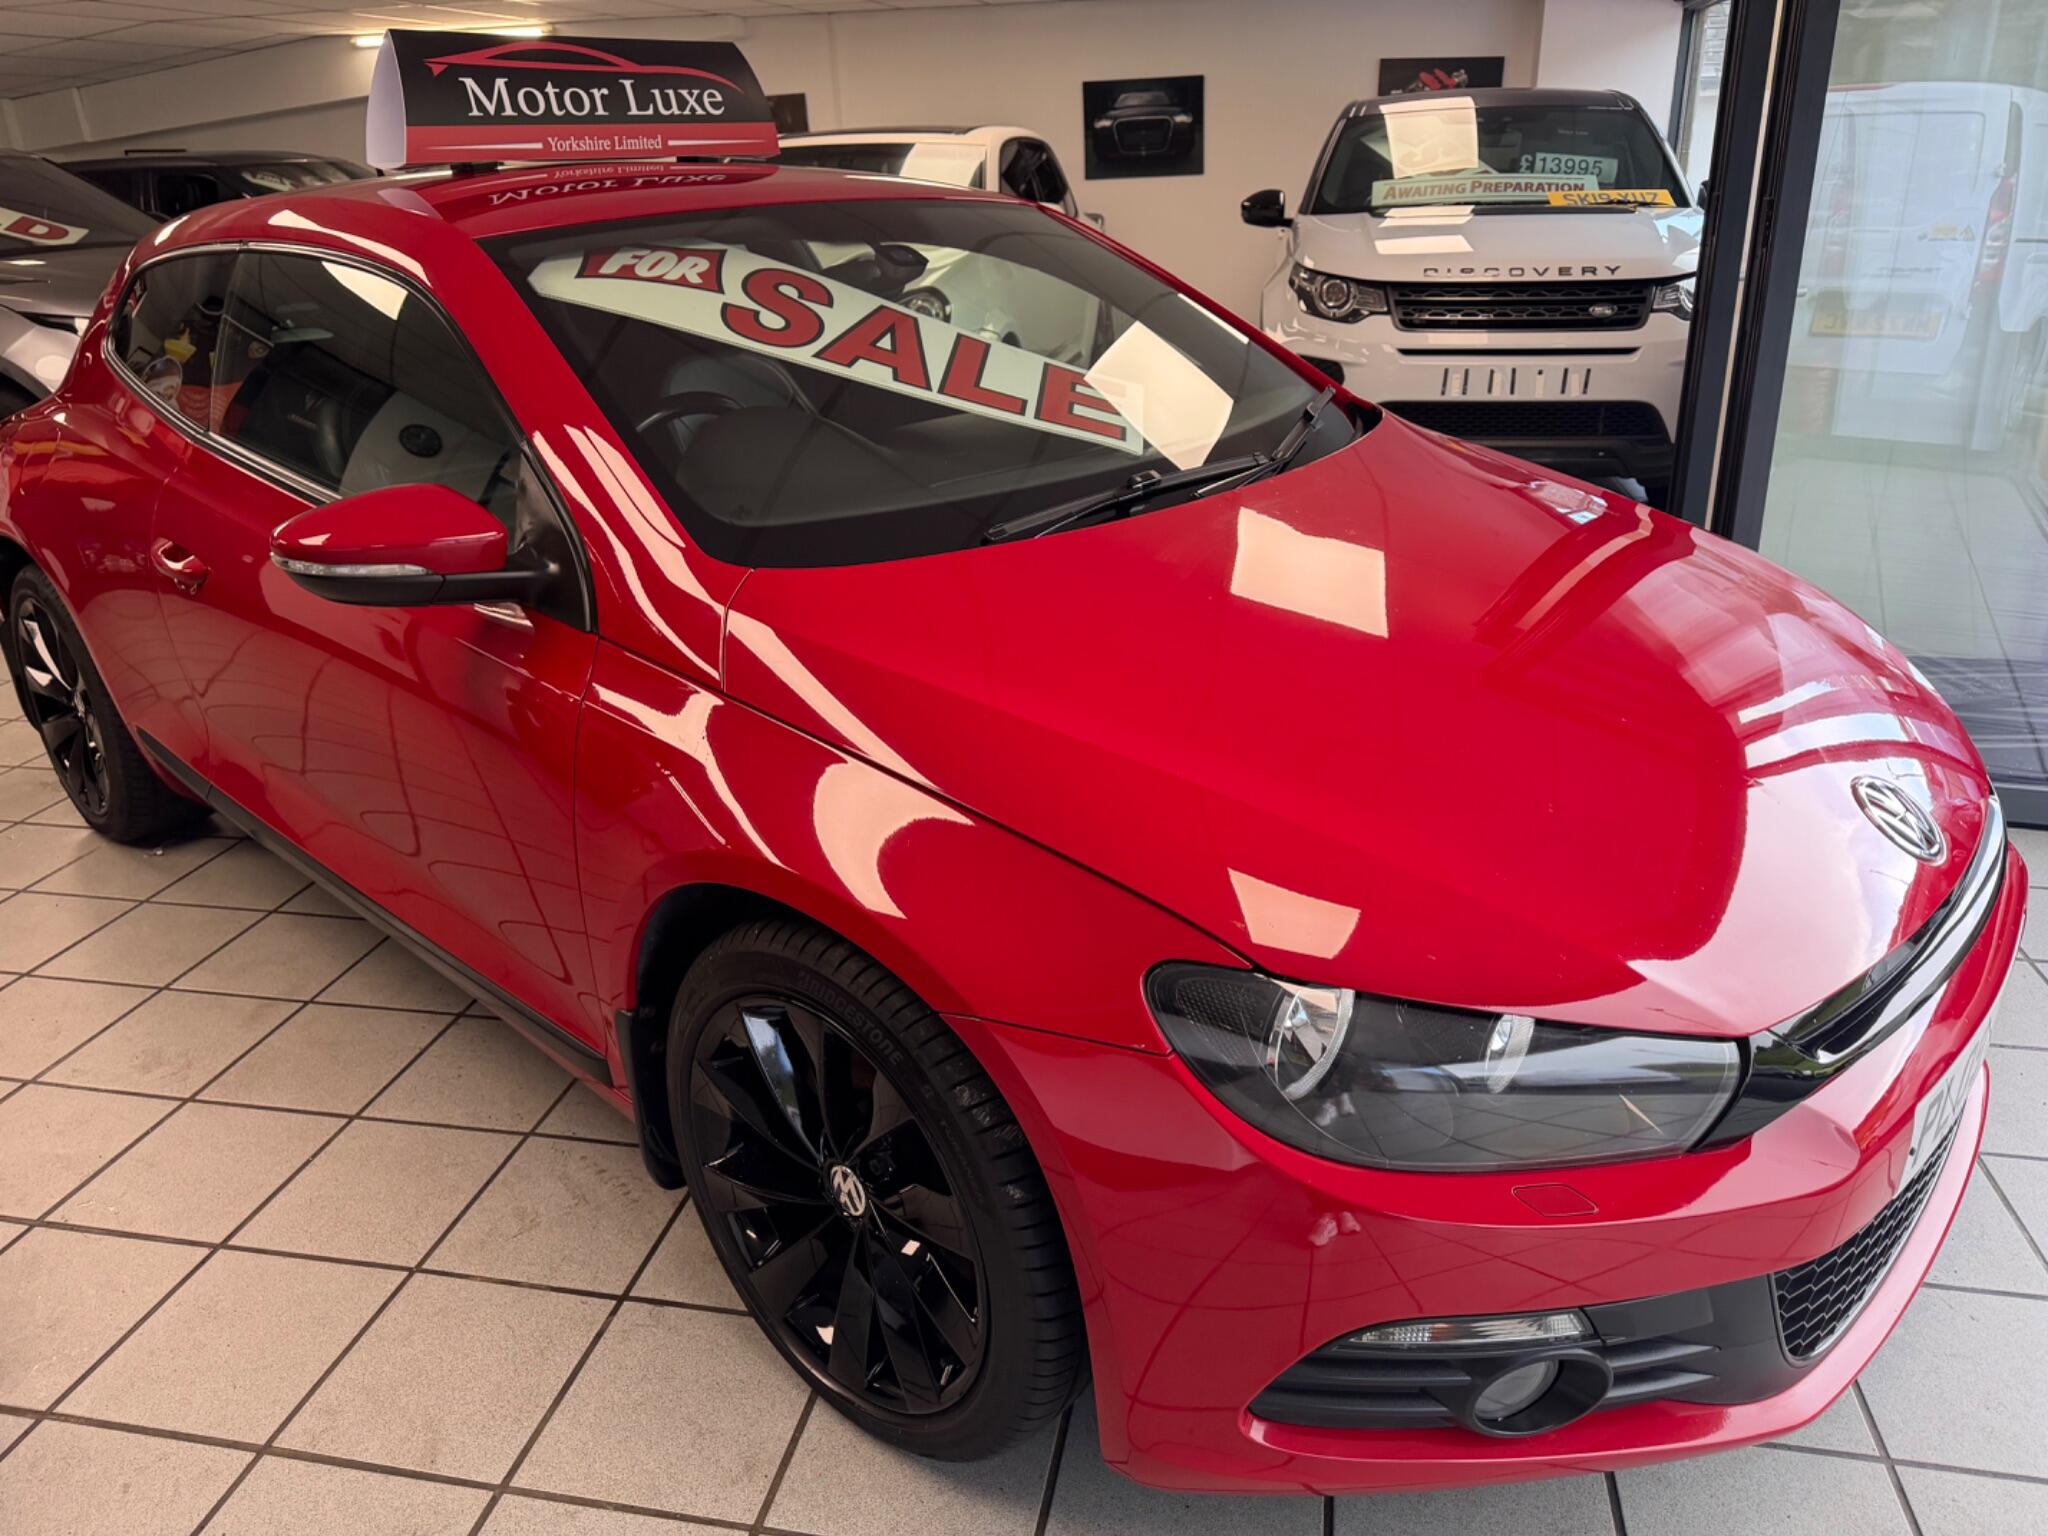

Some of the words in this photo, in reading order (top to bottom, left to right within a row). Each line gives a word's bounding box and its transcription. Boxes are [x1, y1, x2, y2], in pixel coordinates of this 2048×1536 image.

[458, 76, 610, 118] Motor
[619, 79, 725, 116] Luxe
[548, 136, 612, 152] Yorkshire
[614, 134, 663, 150] Limited
[598, 247, 711, 286] FOR
[720, 267, 1127, 441] SALE
